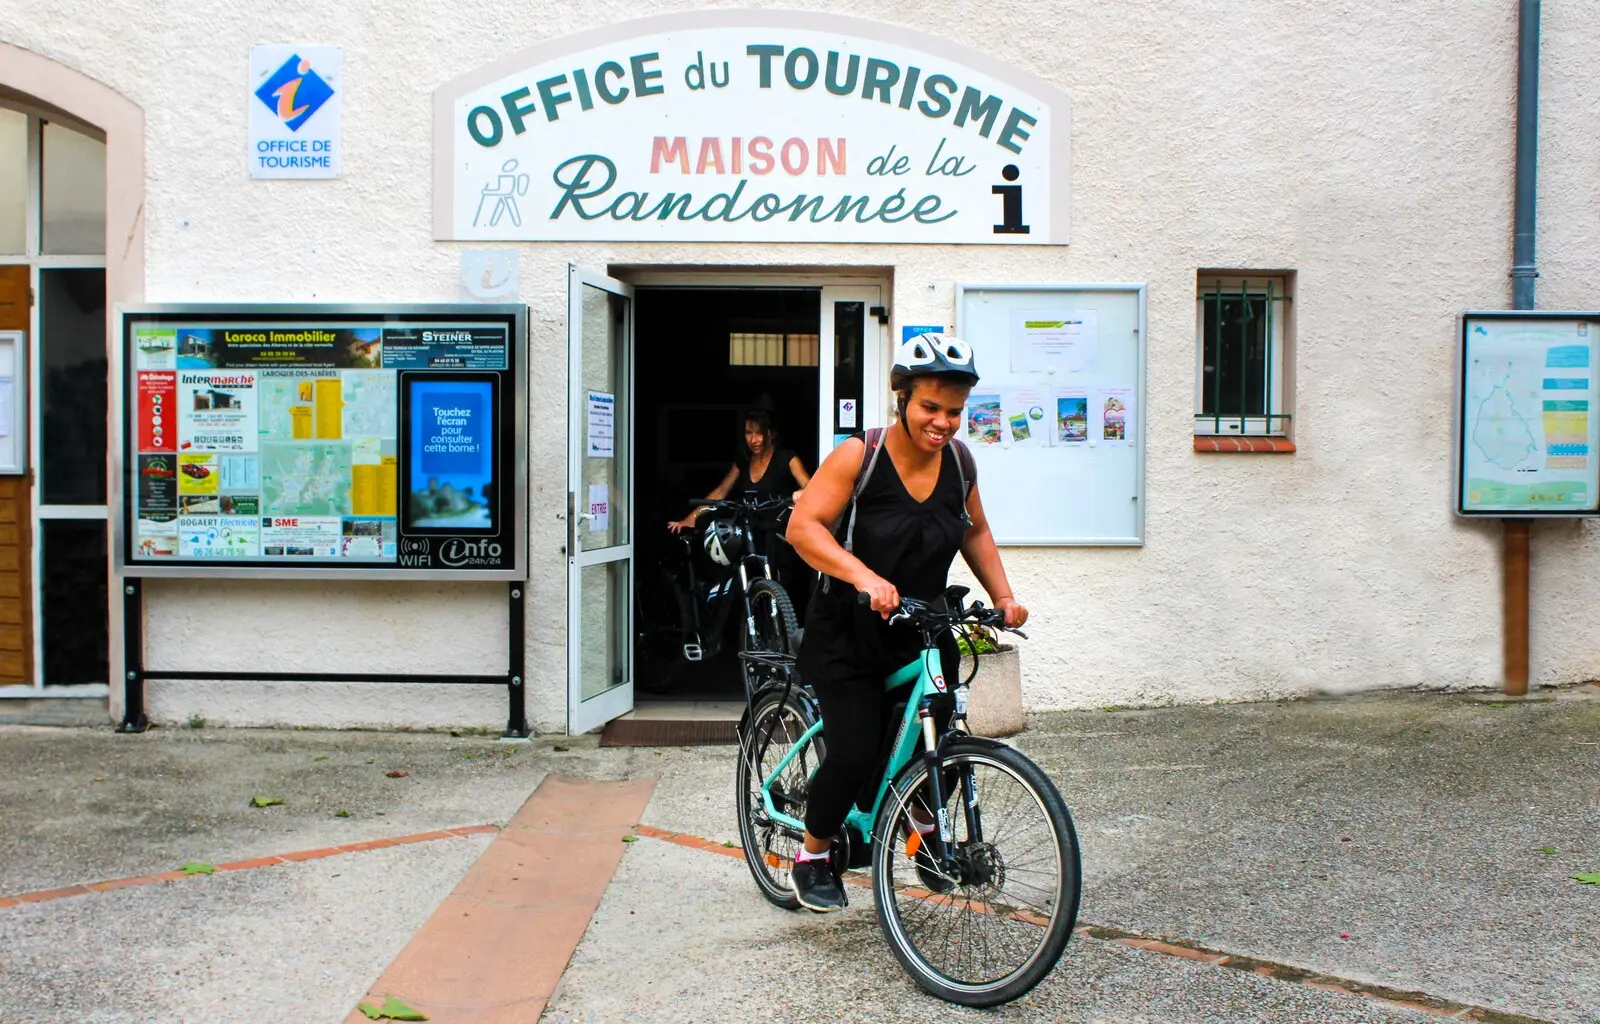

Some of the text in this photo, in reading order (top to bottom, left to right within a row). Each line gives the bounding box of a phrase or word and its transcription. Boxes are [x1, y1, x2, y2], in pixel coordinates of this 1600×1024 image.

[466, 44, 1038, 155] OFFICE du TOURISME
[256, 140, 332, 152] OFFICE DE
[649, 135, 978, 177] MAISON de la
[257, 156, 331, 168] TOURISME
[548, 153, 959, 224] Randonnée
[991, 163, 1031, 235] i
[225, 331, 336, 342] Laroca Immobilier
[422, 331, 473, 342] STEINER
[182, 374, 255, 386] Intermarché
[433, 407, 471, 417] Touchez
[437, 416, 467, 426] l'écran
[441, 427, 462, 437] pour
[431, 435, 473, 444] consulter
[424, 444, 447, 453] cette
[448, 444, 475, 453] borne
[180, 518, 218, 527] BOGAERT
[274, 518, 299, 527] SME
[399, 555, 431, 566] WIFI
[468, 557, 501, 565] 24h/24
